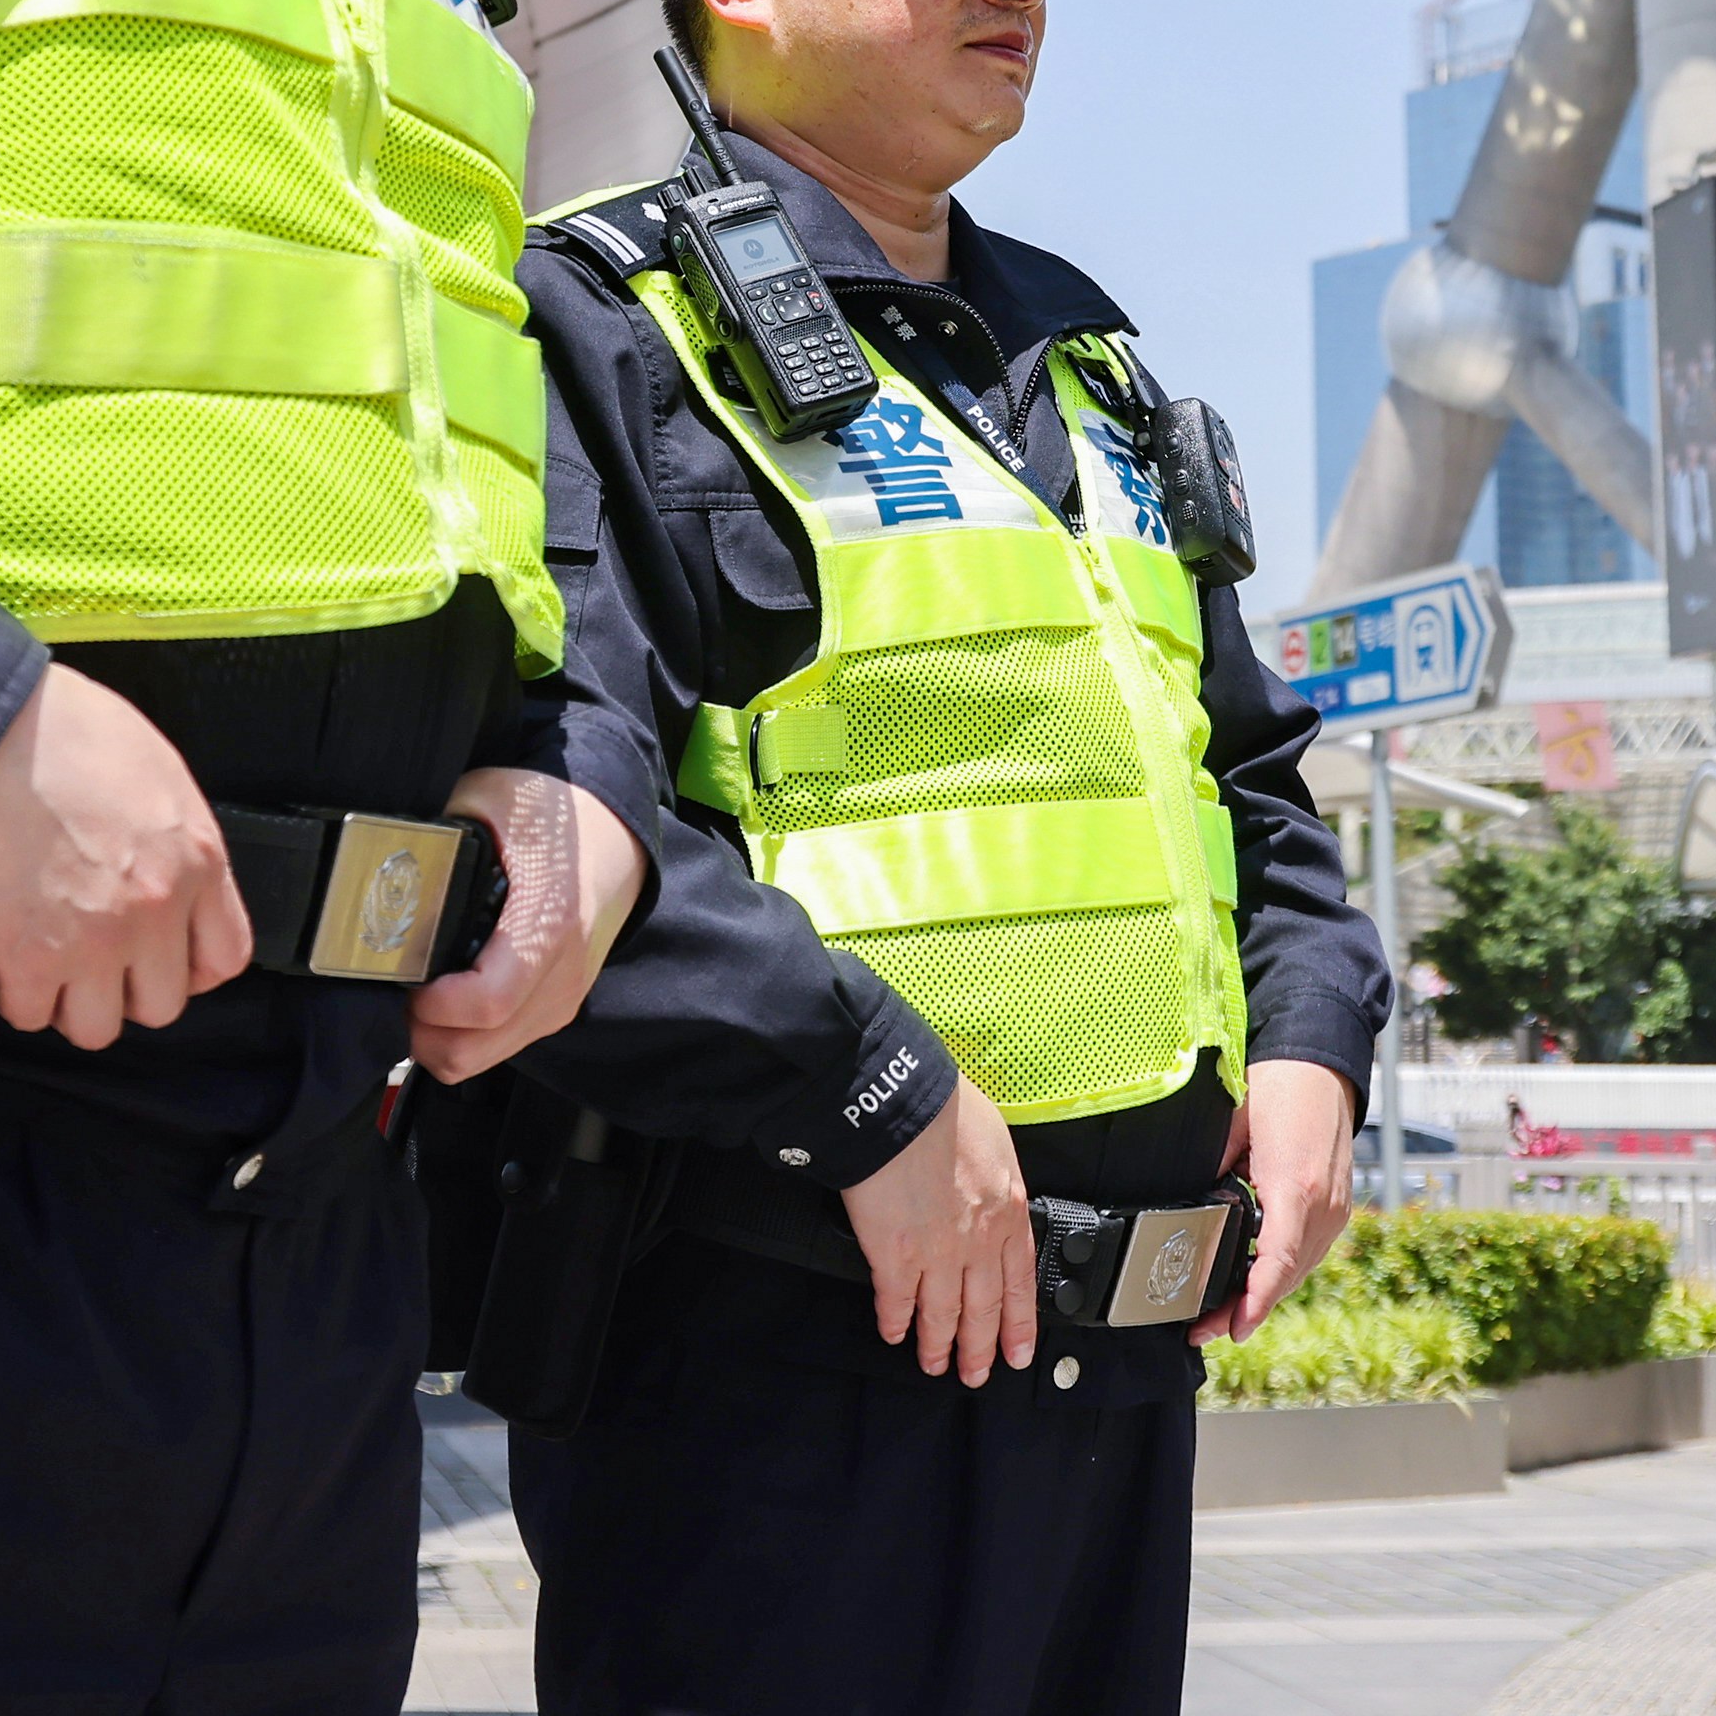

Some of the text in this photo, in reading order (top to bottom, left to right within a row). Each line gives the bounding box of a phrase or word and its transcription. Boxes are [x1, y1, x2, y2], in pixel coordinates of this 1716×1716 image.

[720, 195, 765, 211] MOTOROLA
[966, 404, 1025, 473] POLICE
[842, 1046, 919, 1130] POLICE
